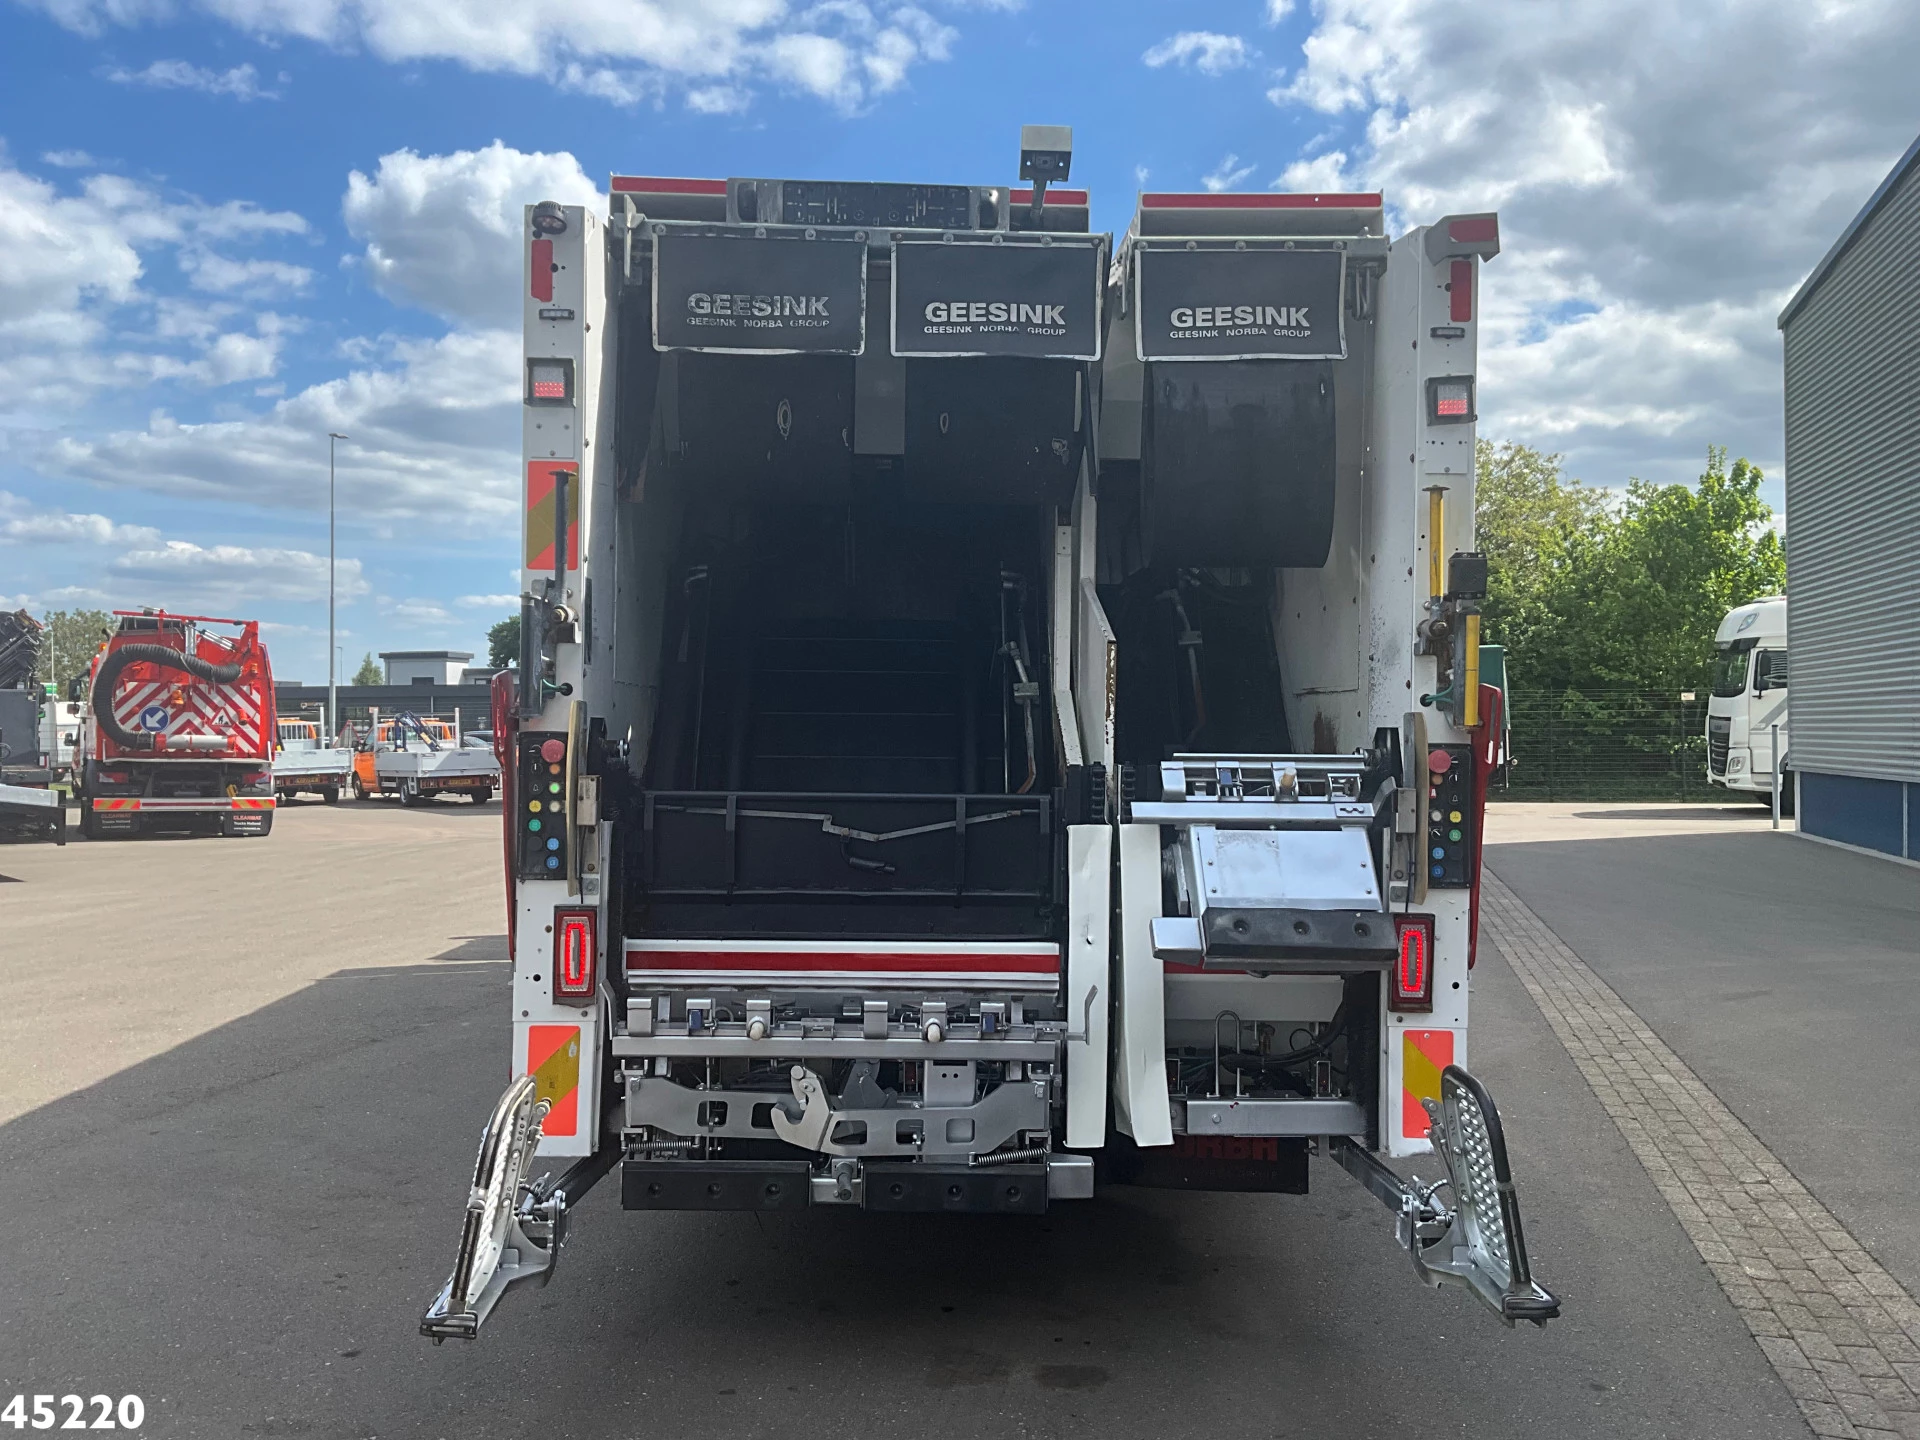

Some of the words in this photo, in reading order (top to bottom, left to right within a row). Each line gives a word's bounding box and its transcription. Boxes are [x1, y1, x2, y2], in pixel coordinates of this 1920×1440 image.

[687, 293, 830, 317] GEESINK
[925, 301, 1066, 325] GEESINK
[686, 317, 737, 327] GEESINK
[743, 319, 784, 328] NORBA
[790, 319, 830, 327] GROUP
[1170, 306, 1310, 327] GEESINK
[924, 325, 973, 334] GEESINK
[1027, 327, 1066, 336] GROUP
[1170, 329, 1218, 338] GEESINK
[1226, 328, 1267, 336] NORBA
[1273, 328, 1311, 338] GROUP
